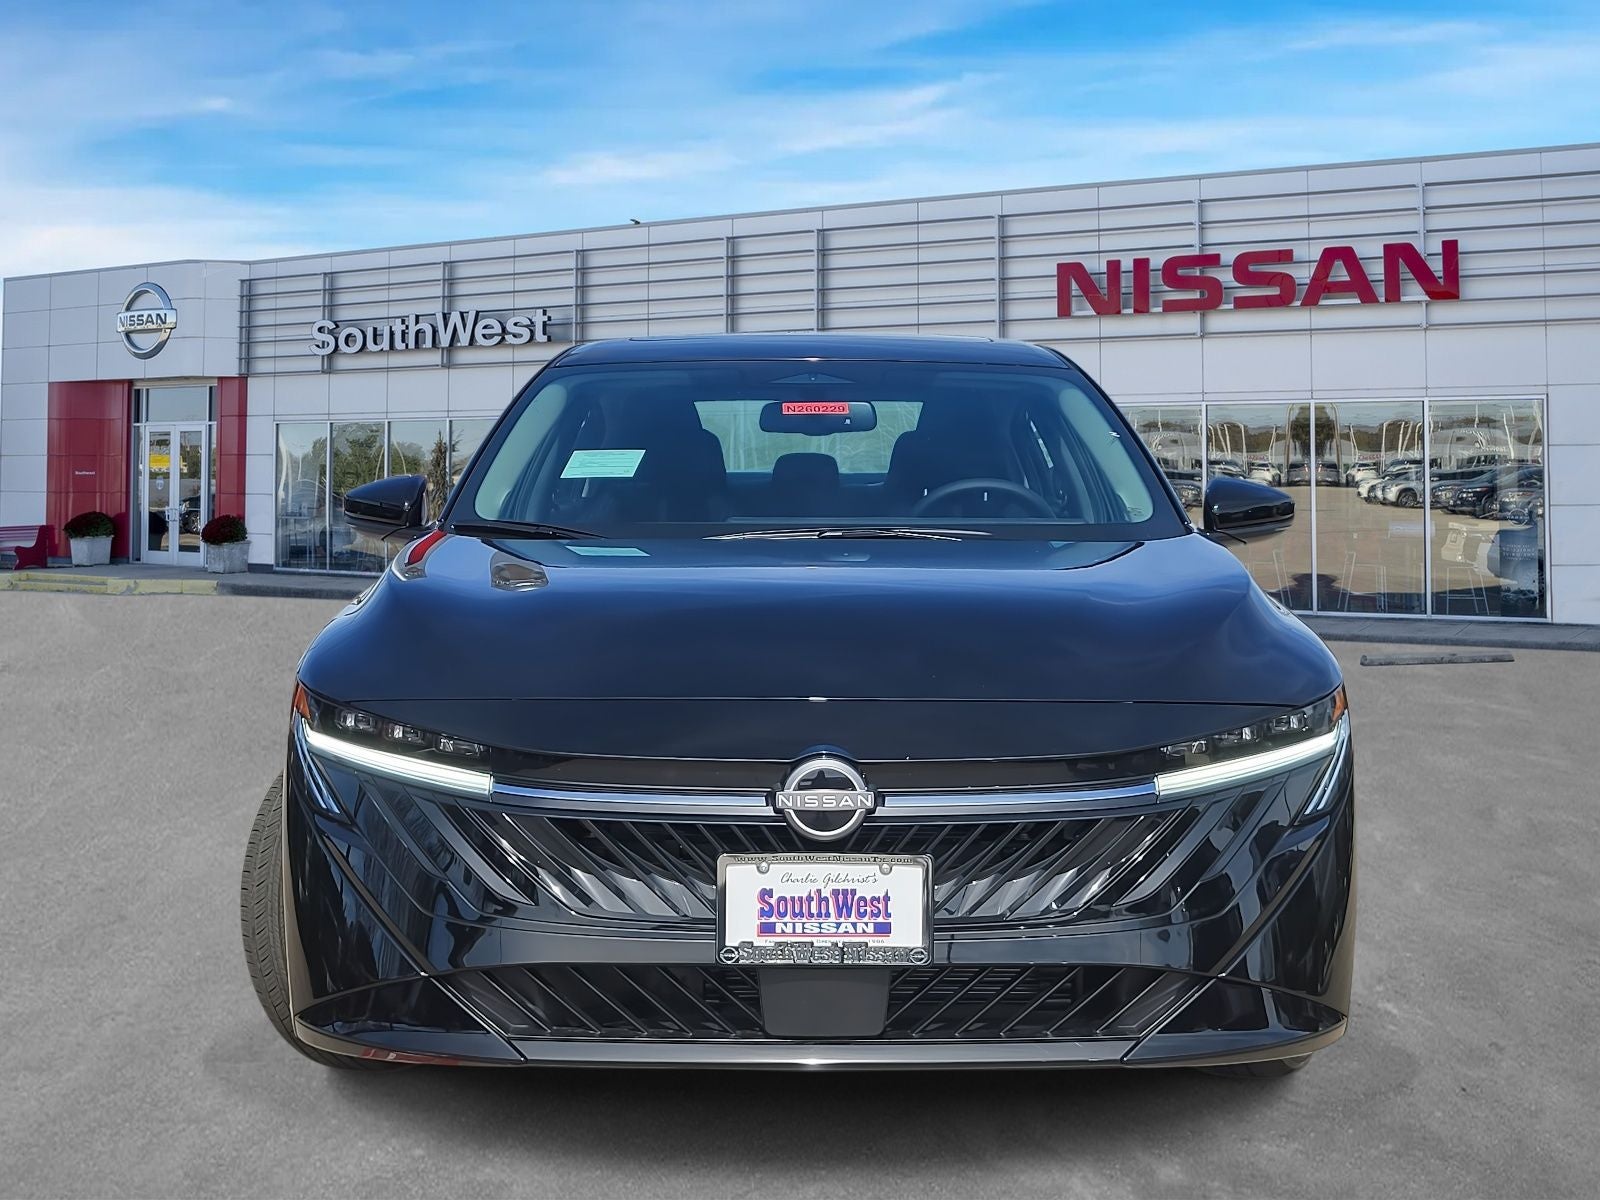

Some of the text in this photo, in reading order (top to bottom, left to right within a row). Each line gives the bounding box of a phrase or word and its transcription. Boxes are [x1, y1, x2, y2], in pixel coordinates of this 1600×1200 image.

[1057, 239, 1460, 318] NISSAN
[119, 312, 167, 328] NISSAN
[309, 309, 550, 356] SouthWest
[778, 795, 872, 808] NISSAN
[780, 872, 818, 883] Charlie
[758, 888, 891, 920] SouthWest
[775, 922, 875, 934] NISSAN
